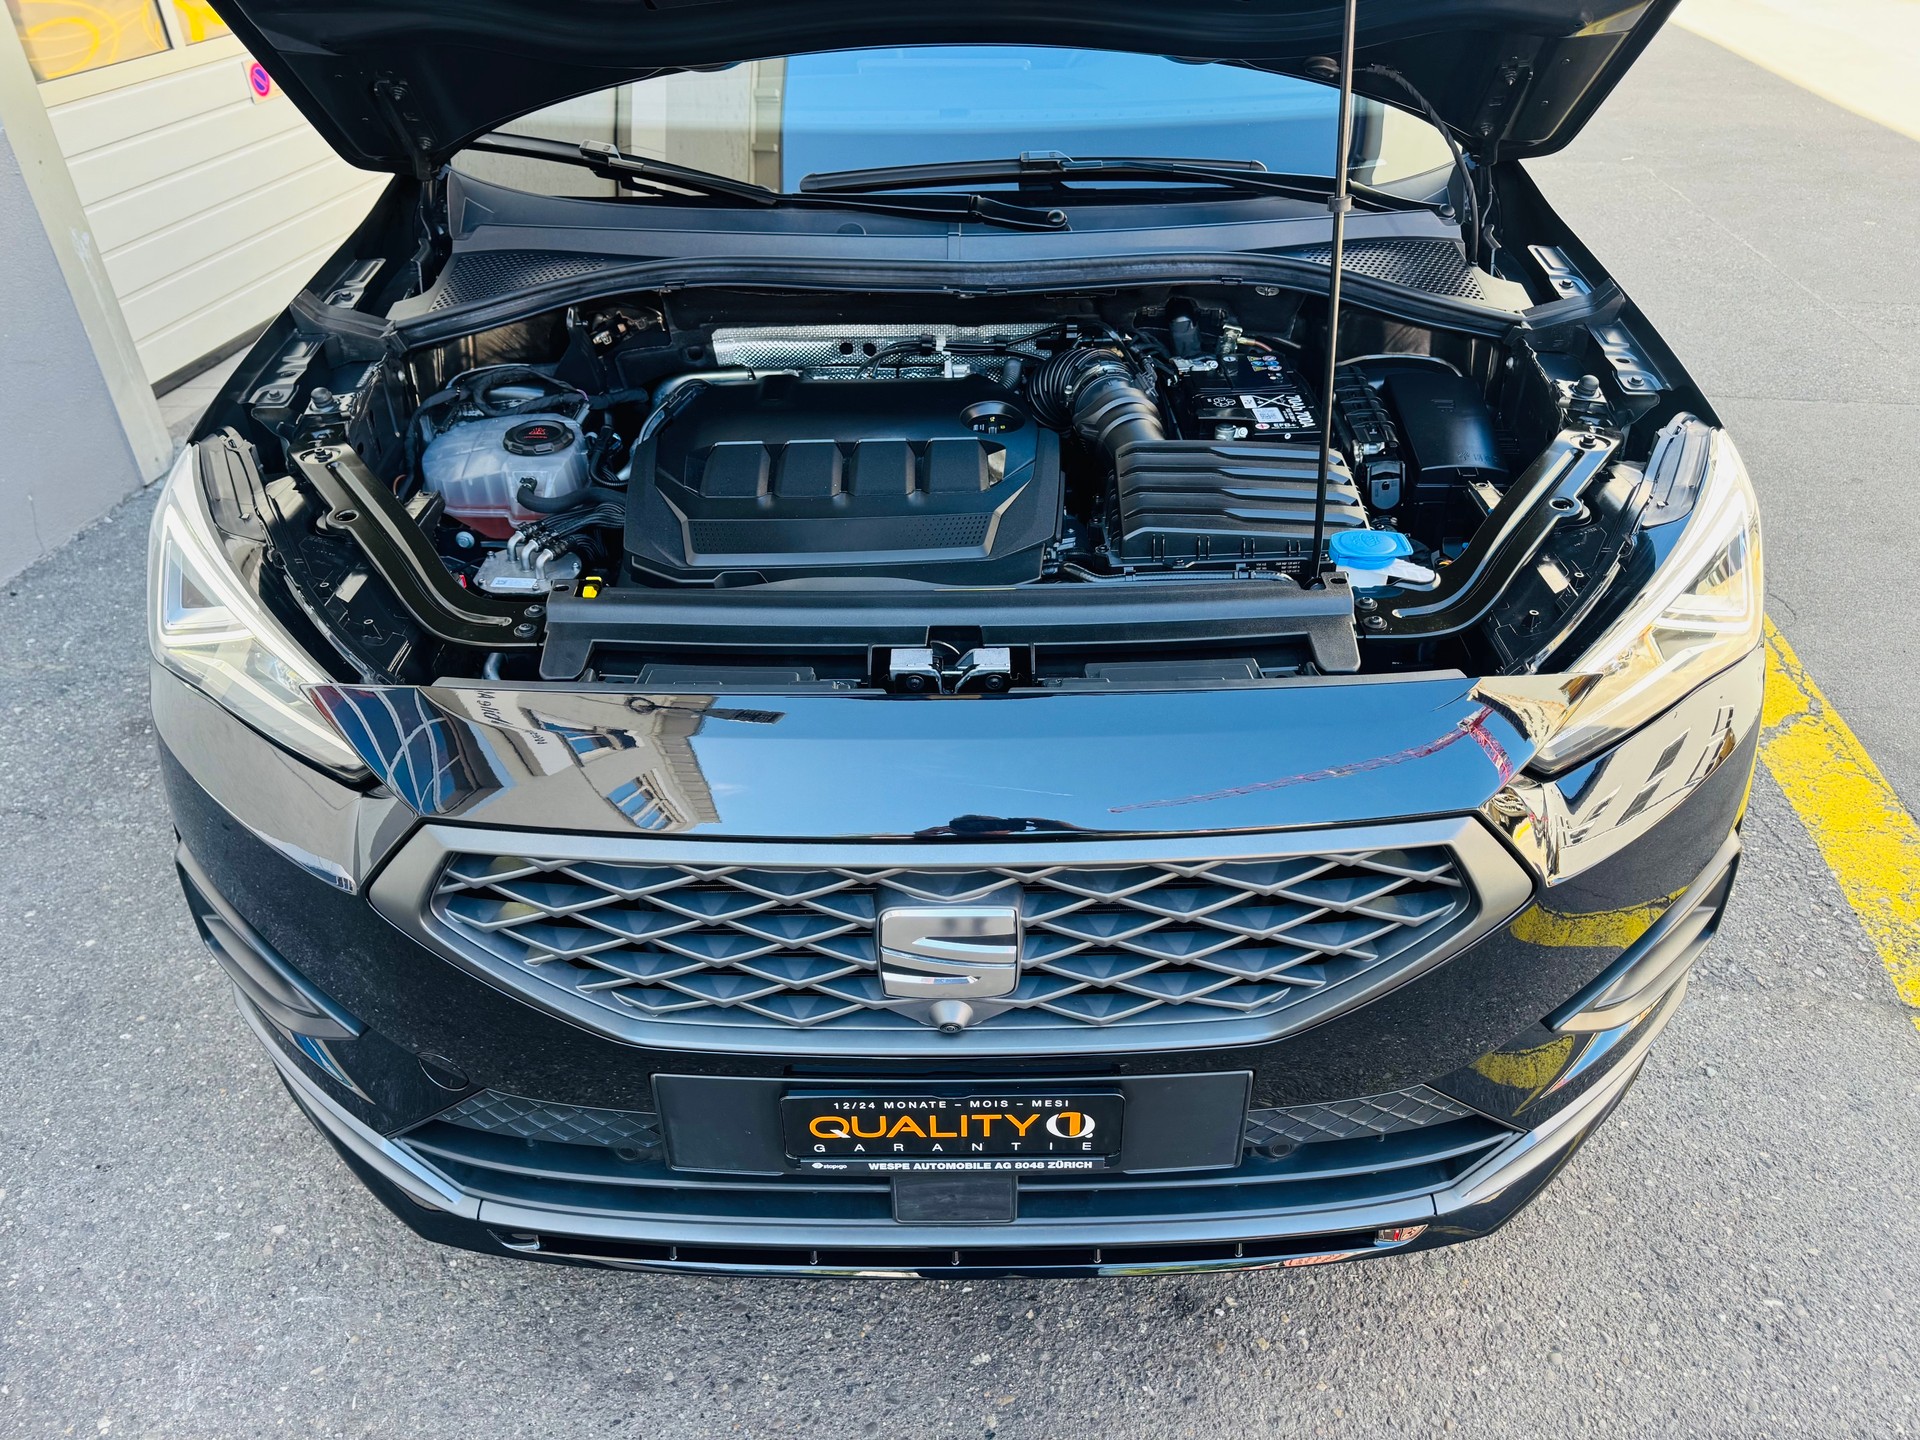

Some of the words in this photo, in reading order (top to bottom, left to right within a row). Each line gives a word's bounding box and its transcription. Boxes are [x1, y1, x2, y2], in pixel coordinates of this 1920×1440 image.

[834, 1101, 876, 1109] 12/24
[884, 1101, 947, 1109] MONATE
[970, 1100, 1009, 1108] MOIS
[1031, 1099, 1069, 1107] MESI
[809, 1113, 1040, 1139] QUALITY
[813, 1141, 1092, 1153] GARANTIE
[868, 1162, 910, 1170] WESPE
[913, 1162, 992, 1170] AUTOMOBILE
[995, 1161, 1012, 1170] AG
[1015, 1161, 1045, 1169] 8048
[1047, 1160, 1093, 1169] ZÜRICH
